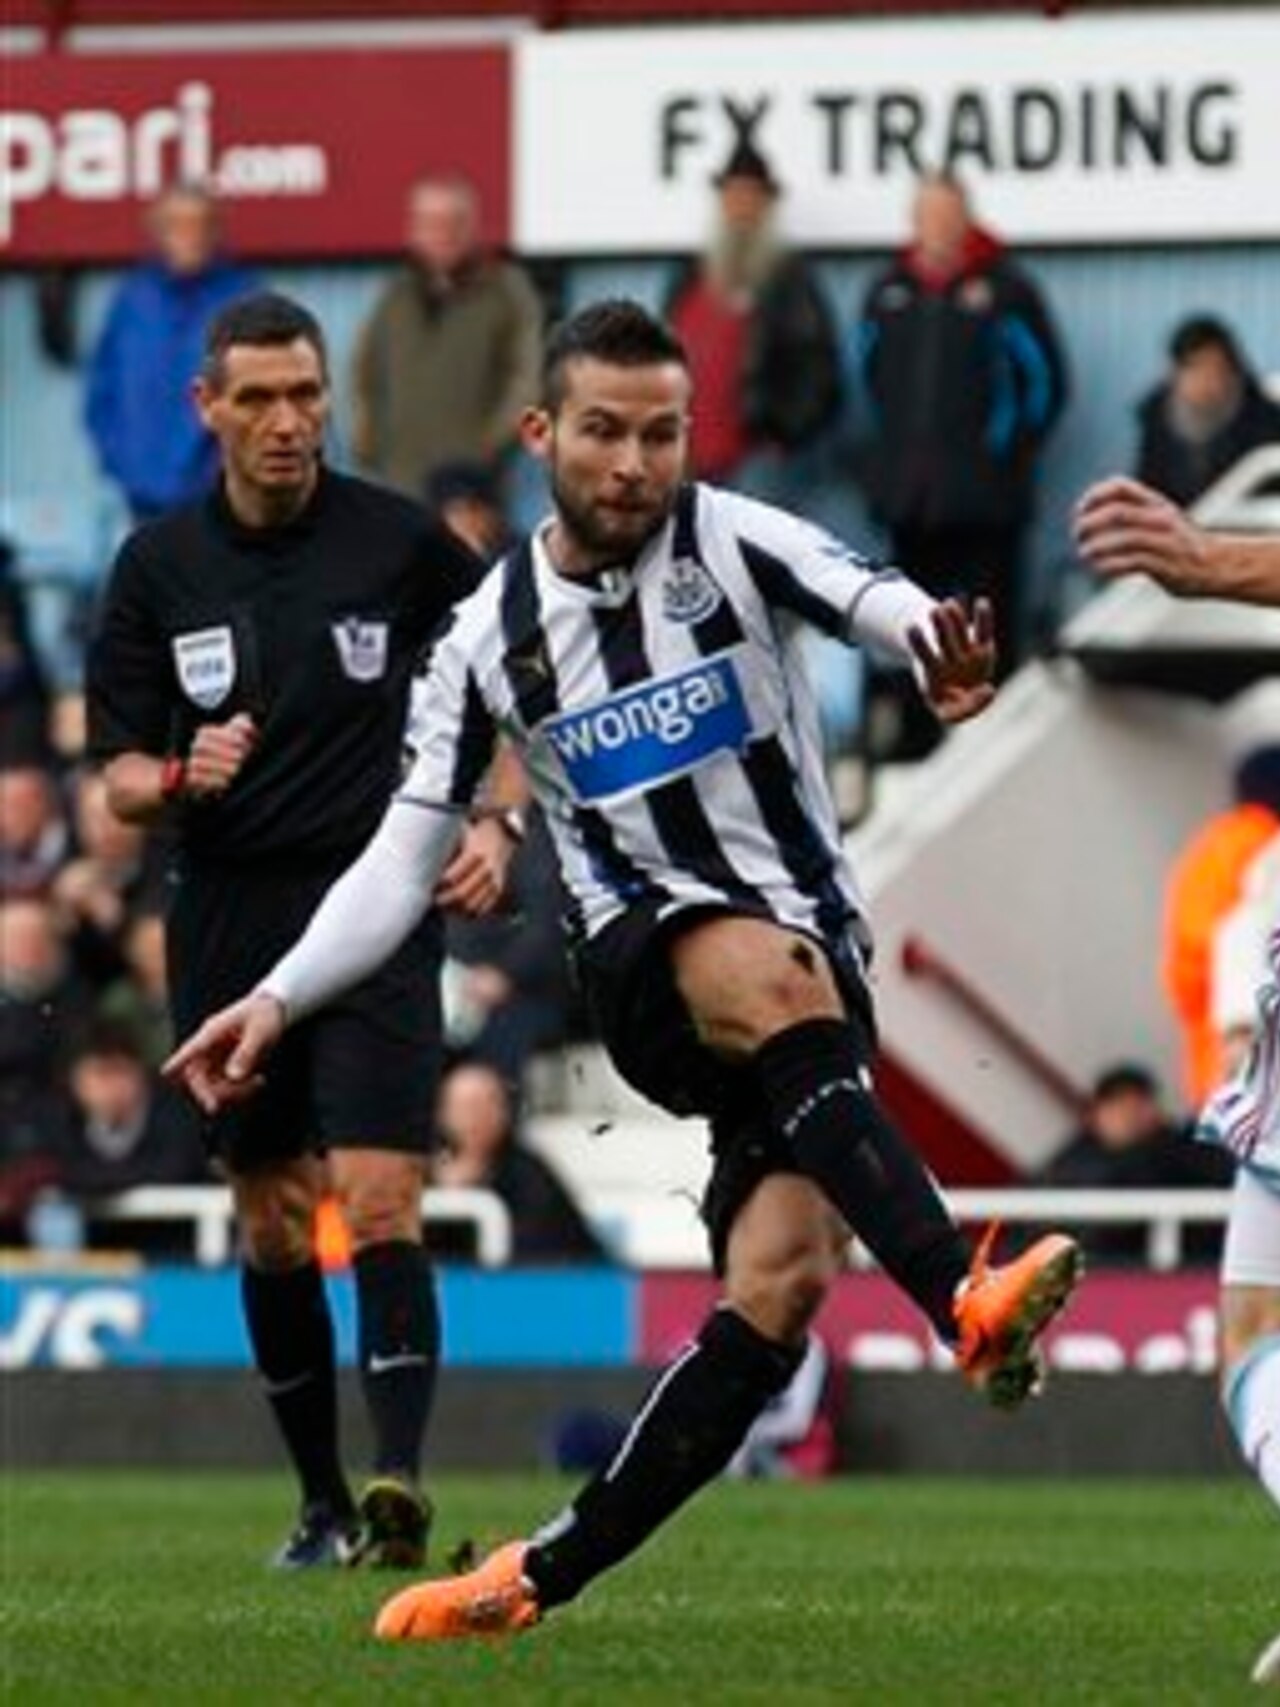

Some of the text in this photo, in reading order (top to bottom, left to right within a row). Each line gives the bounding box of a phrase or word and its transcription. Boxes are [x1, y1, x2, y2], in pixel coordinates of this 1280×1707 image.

[659, 84, 1237, 179] FX TRADING
[551, 672, 719, 762] wonga
